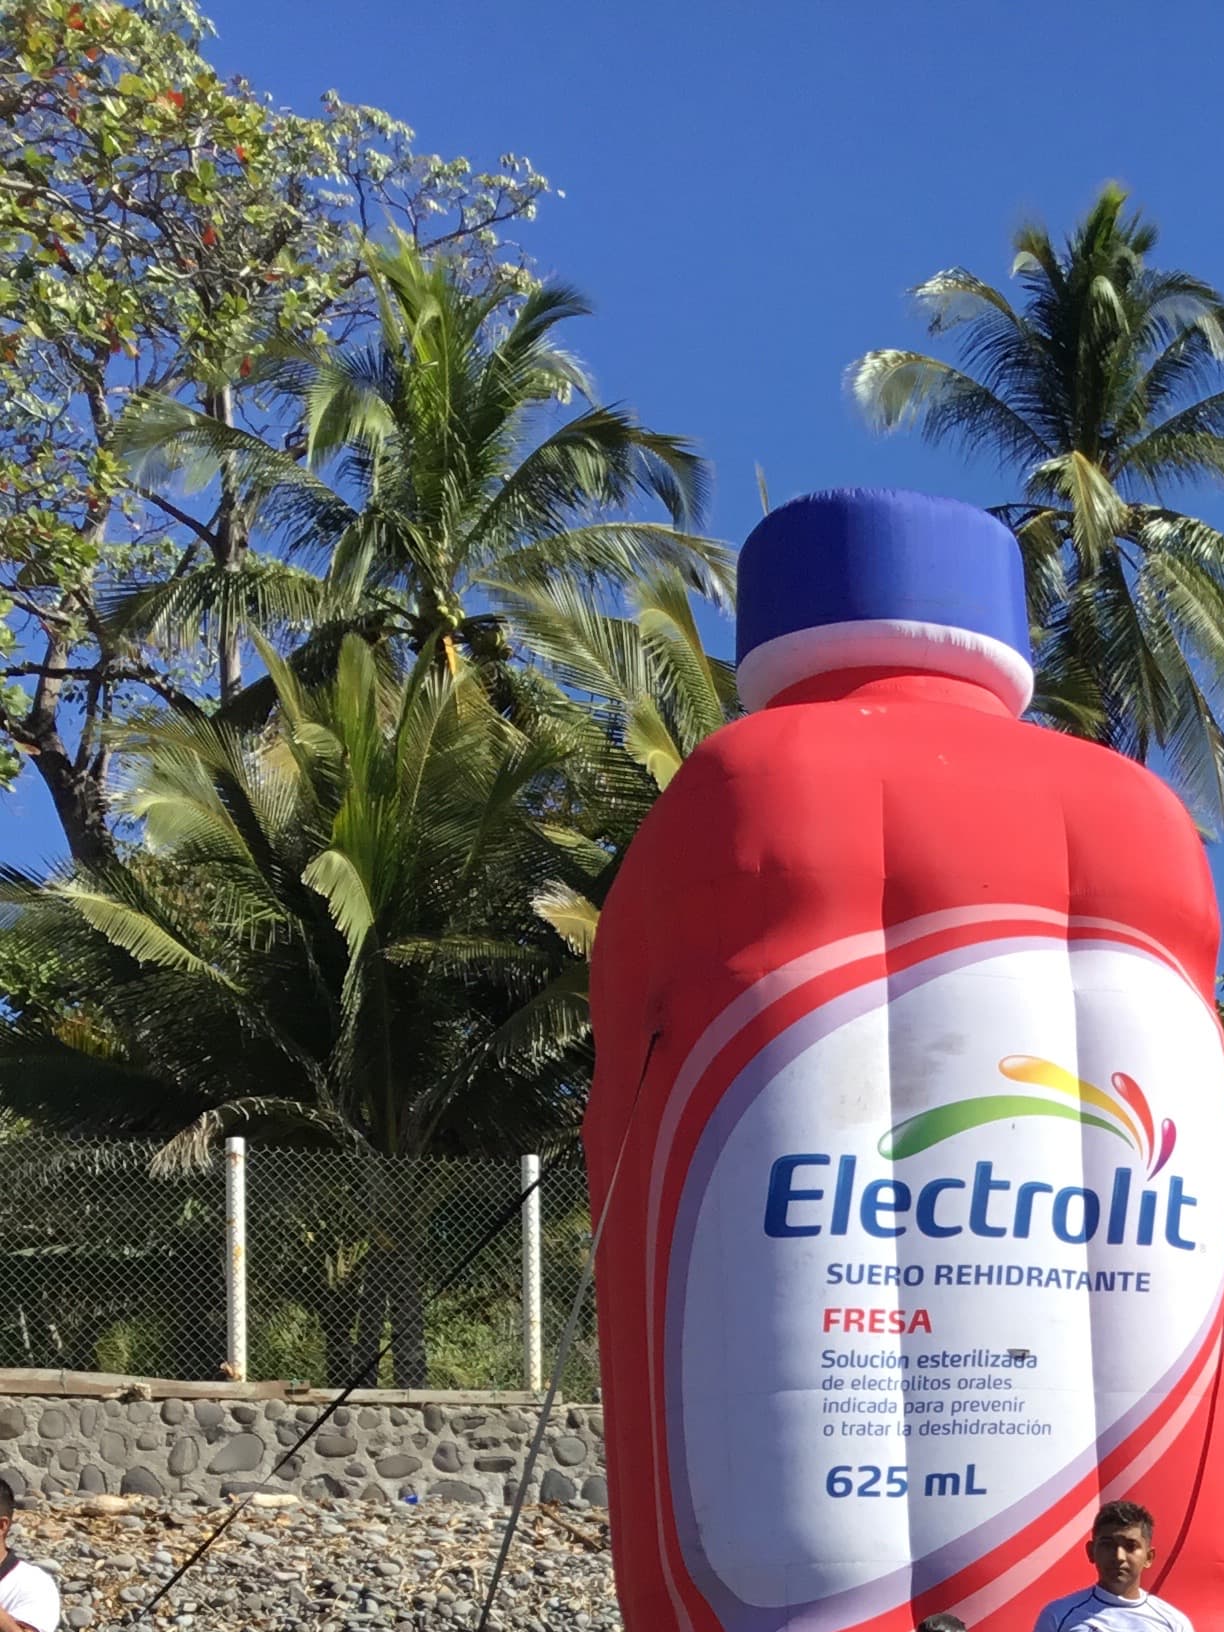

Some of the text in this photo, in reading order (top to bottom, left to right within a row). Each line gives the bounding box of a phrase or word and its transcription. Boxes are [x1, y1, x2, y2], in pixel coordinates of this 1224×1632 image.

[763, 1153, 1198, 1252] Electrolit
[826, 1262, 1152, 1293] SUERO REHIDRATANTE
[822, 1307, 933, 1335] FRESA
[820, 1349, 1038, 1369] Solución esterilizada
[821, 1374, 1013, 1392] de electrolitos orales
[822, 1396, 1026, 1416] indicada para prevenir
[822, 1418, 1053, 1437] o tratar la deshidratación
[825, 1463, 988, 1499] 625 mL
